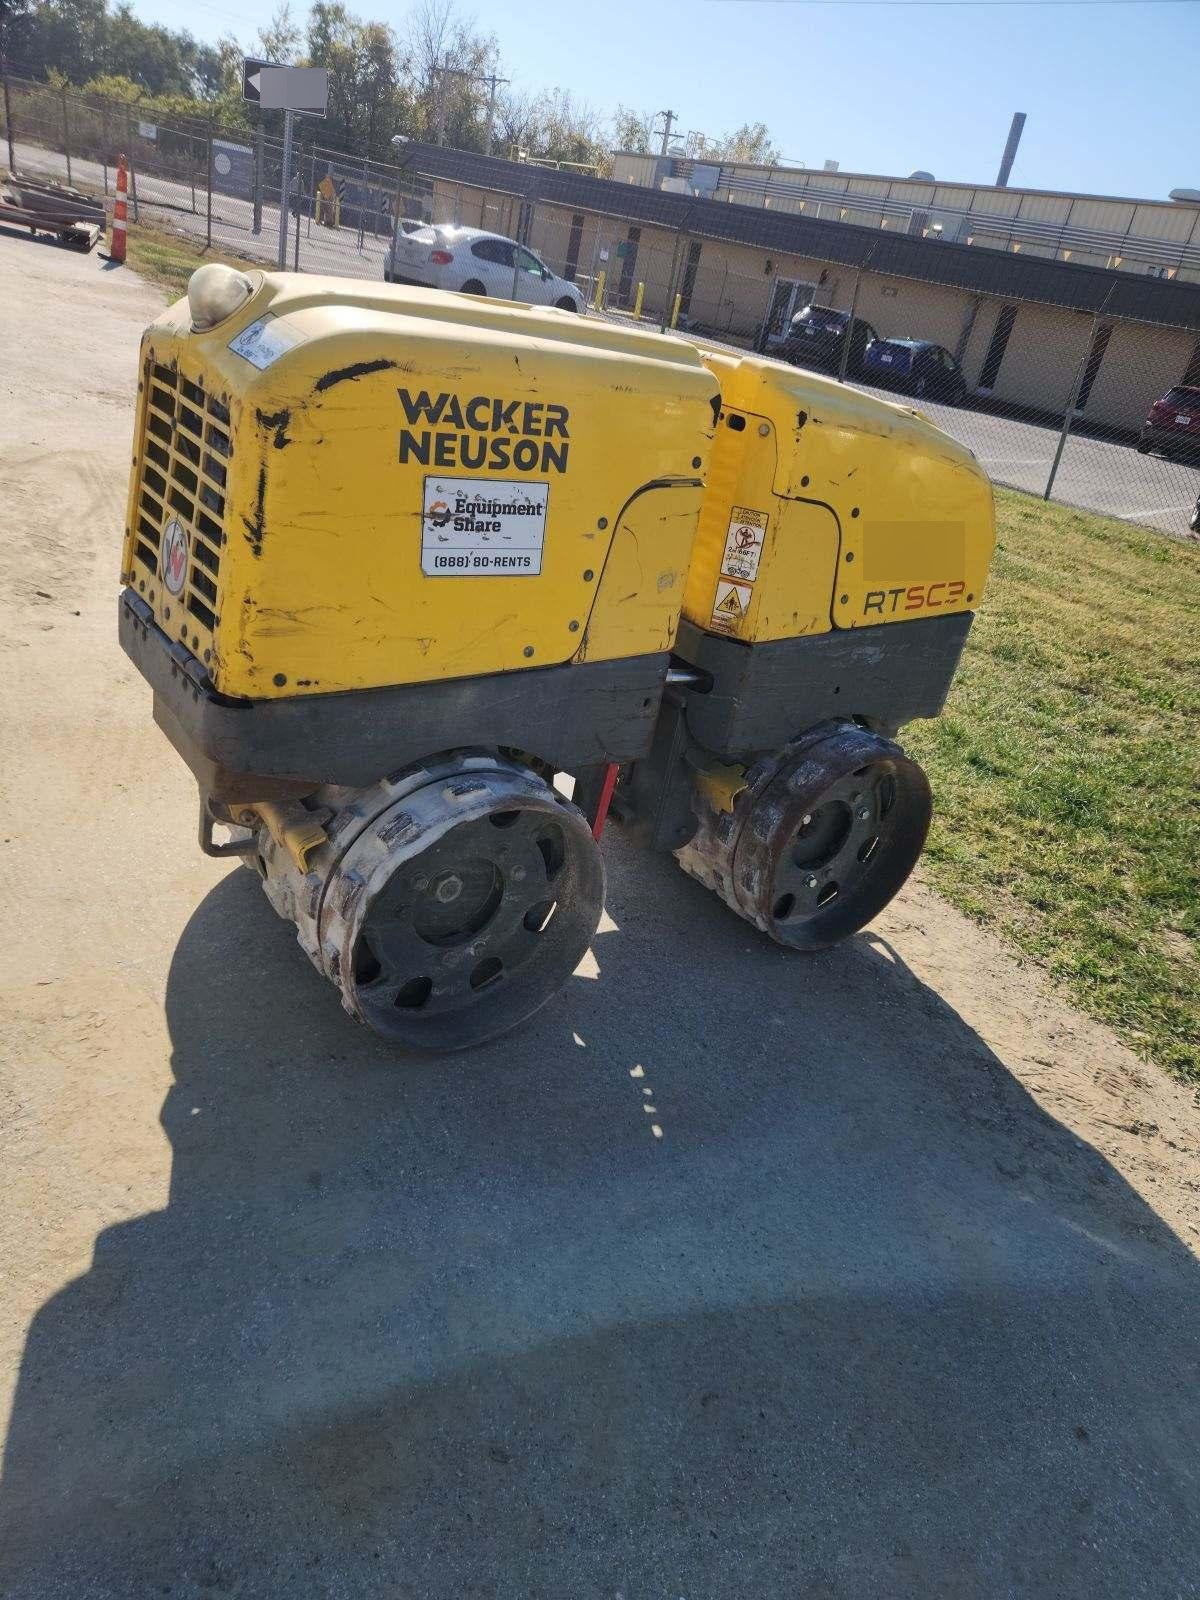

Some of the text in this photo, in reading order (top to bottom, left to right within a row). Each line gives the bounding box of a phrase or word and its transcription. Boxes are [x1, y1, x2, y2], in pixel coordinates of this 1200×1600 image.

[397, 388, 570, 438] WACKER
[399, 430, 569, 474] NEUSON
[454, 498, 543, 517] Equipment
[453, 516, 502, 532] Share
[434, 556, 531, 568] (888) 80-RENTS
